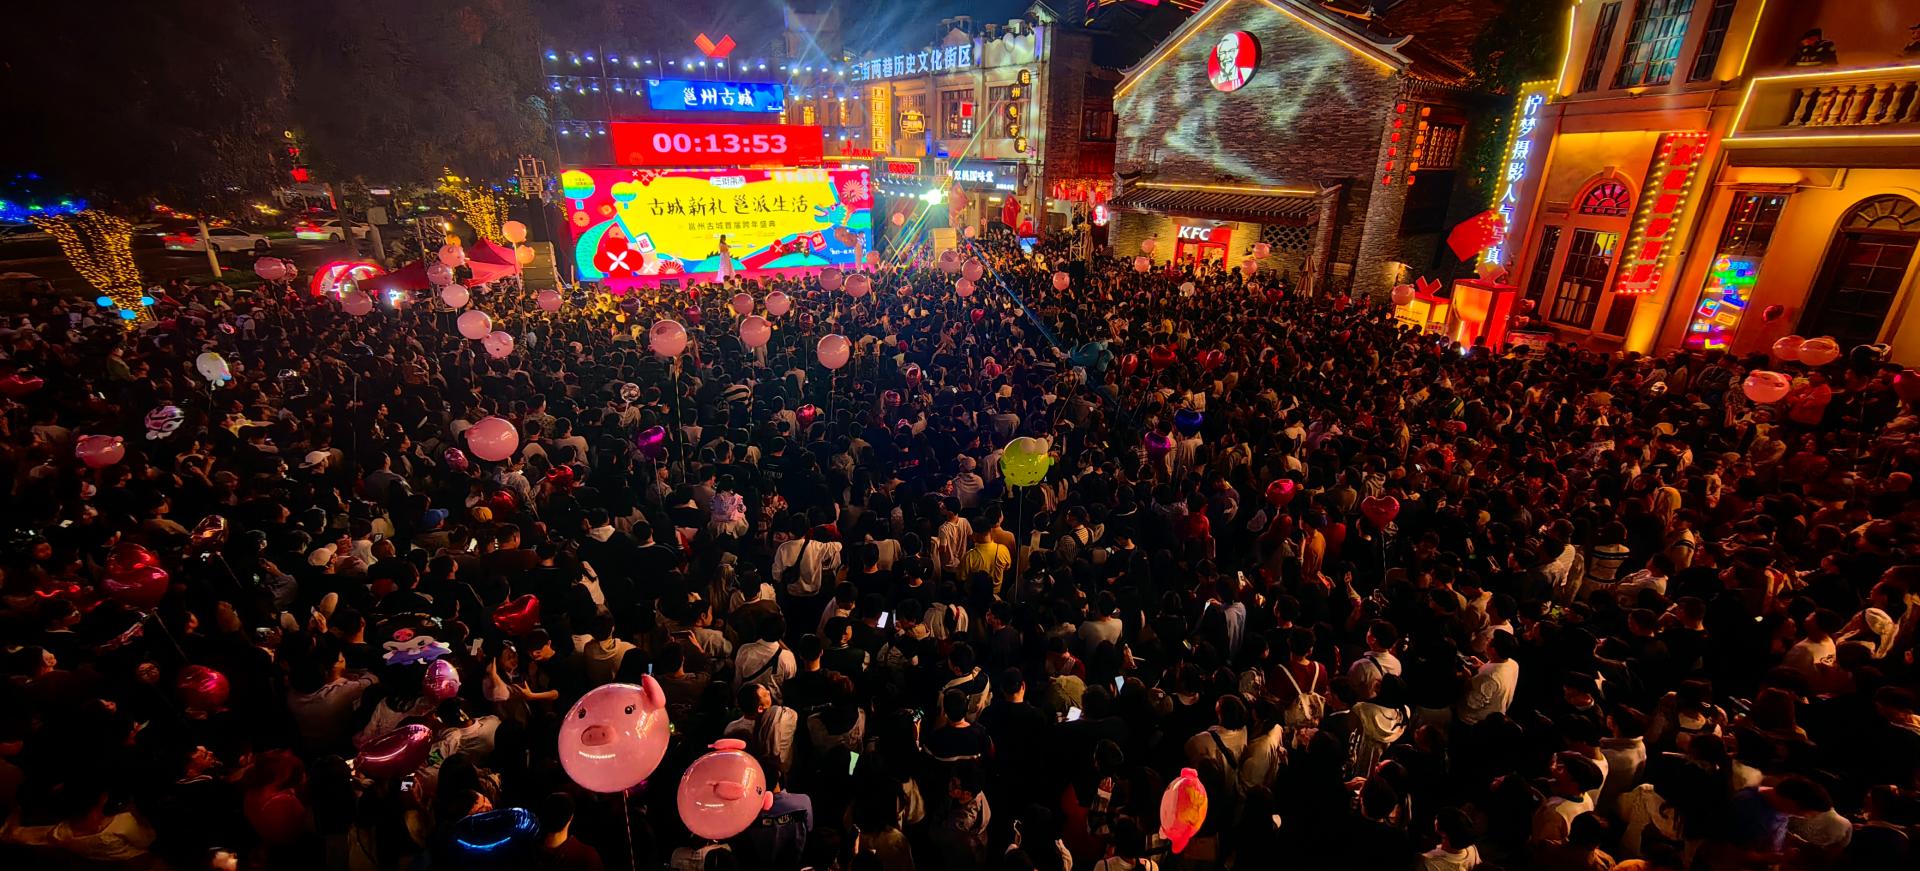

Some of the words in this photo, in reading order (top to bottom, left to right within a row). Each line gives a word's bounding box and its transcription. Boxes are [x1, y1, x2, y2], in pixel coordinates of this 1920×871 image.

[851, 44, 972, 82] 三街两巷历史文化街区
[683, 87, 754, 107] 邕州古城
[652, 133, 787, 154] 00:13:53
[648, 196, 728, 216] 古城新礼
[734, 194, 809, 215] 邕派生活
[1178, 225, 1211, 241] KFC
